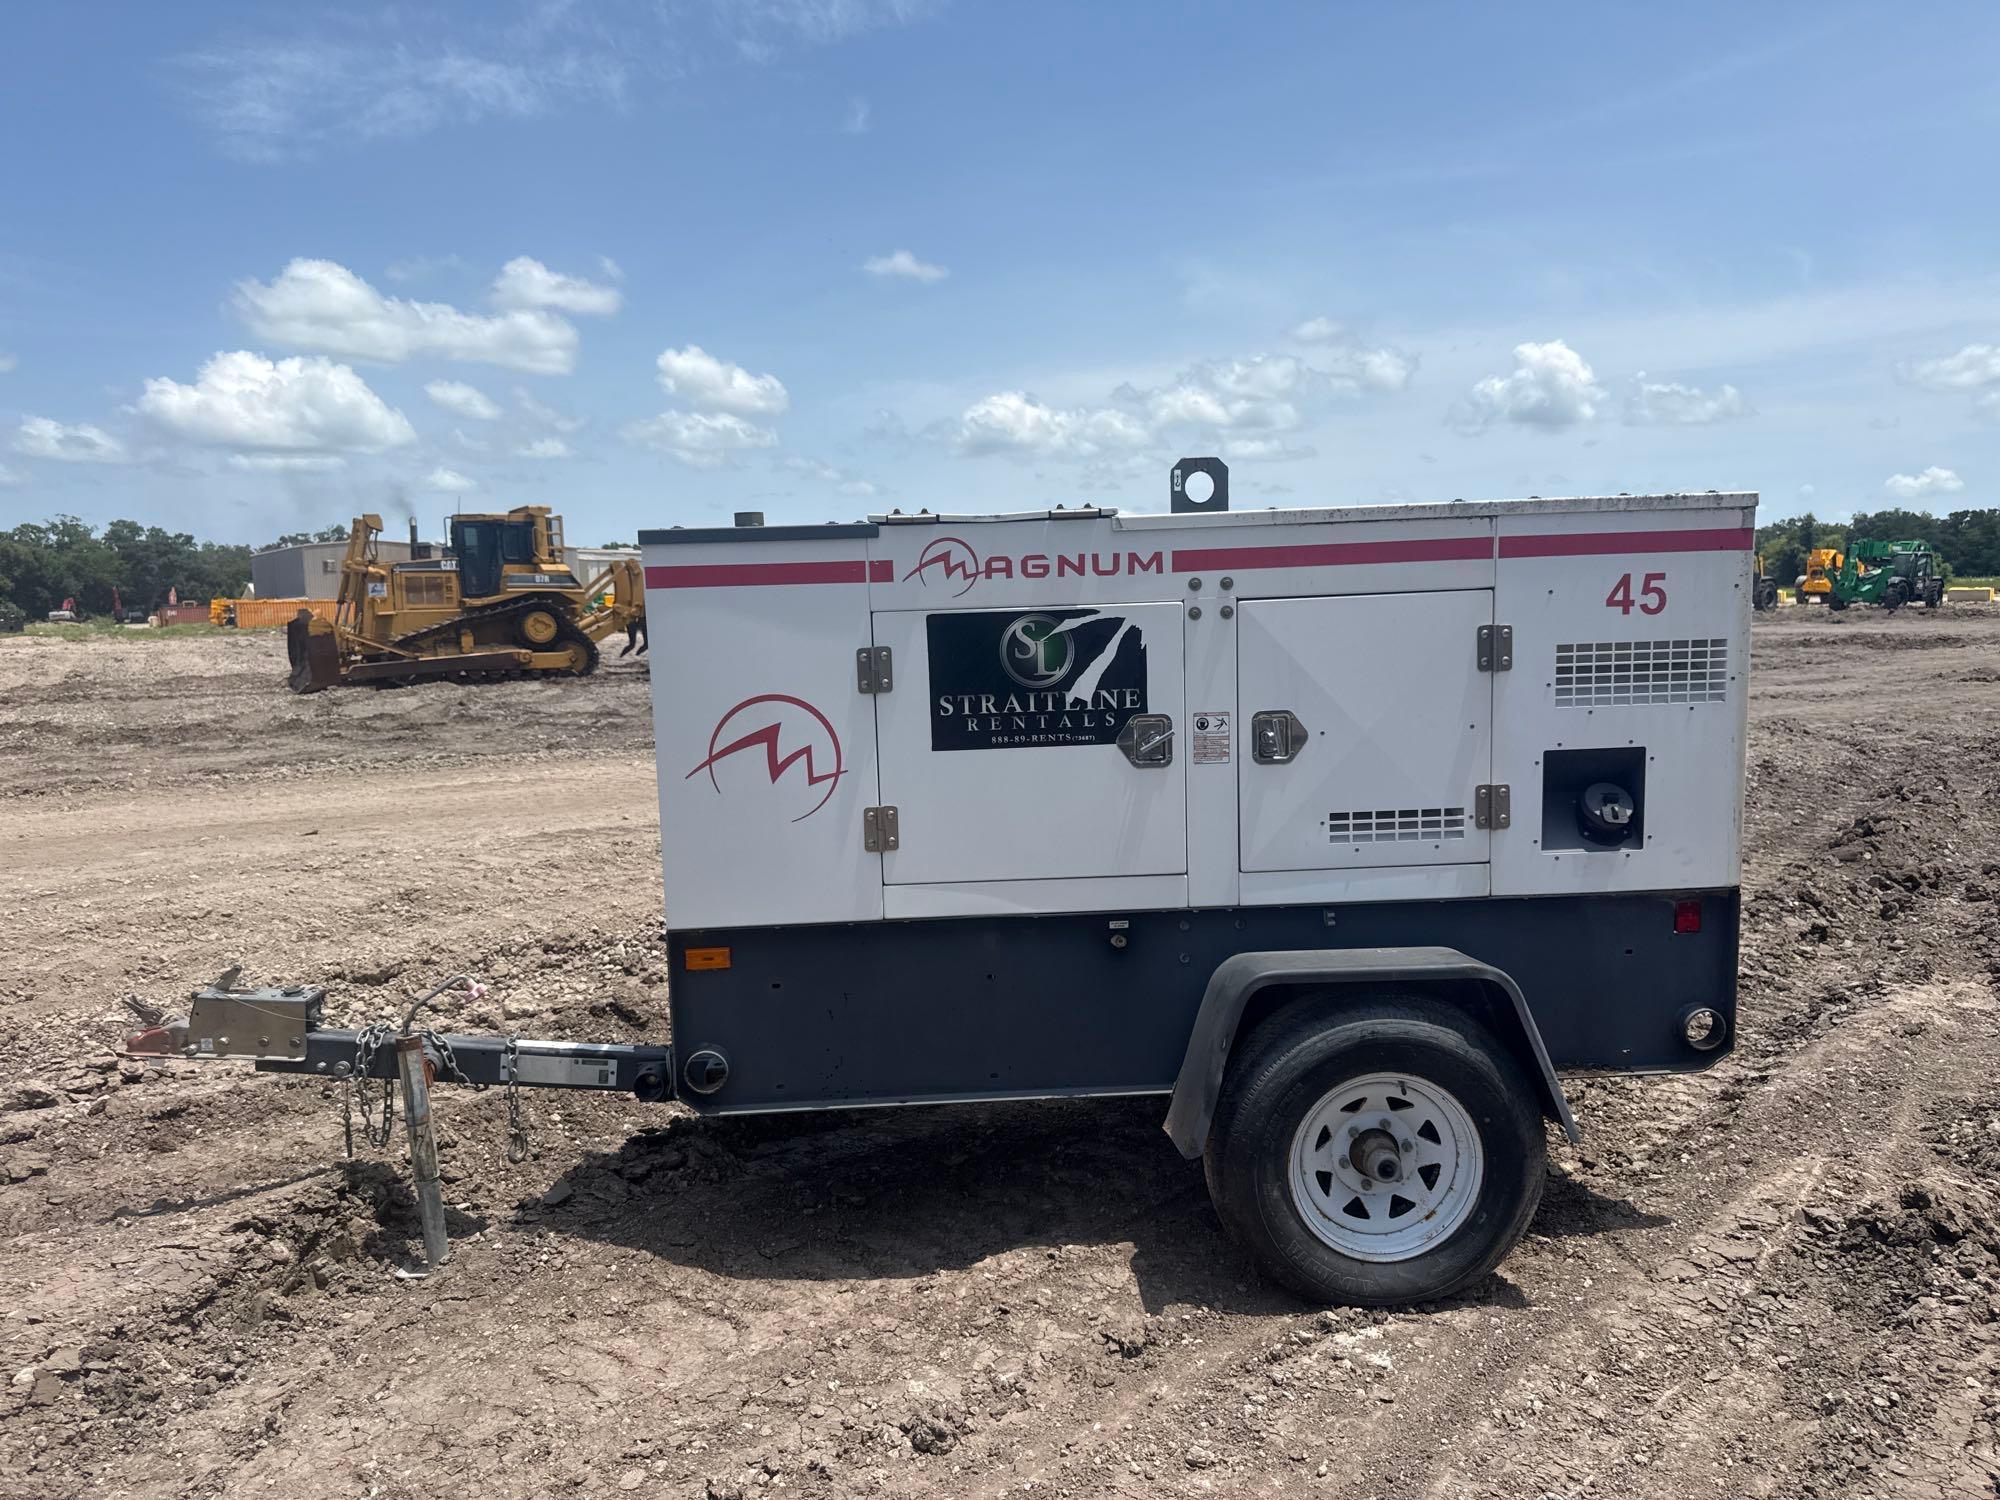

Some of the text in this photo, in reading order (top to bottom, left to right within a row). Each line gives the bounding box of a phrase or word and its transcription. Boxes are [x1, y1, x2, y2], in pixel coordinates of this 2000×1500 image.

[440, 560, 456, 570] CAT
[903, 538, 1164, 595] MAGNUM
[1606, 572, 1668, 616] 45
[967, 712, 1115, 732] RENTALS
